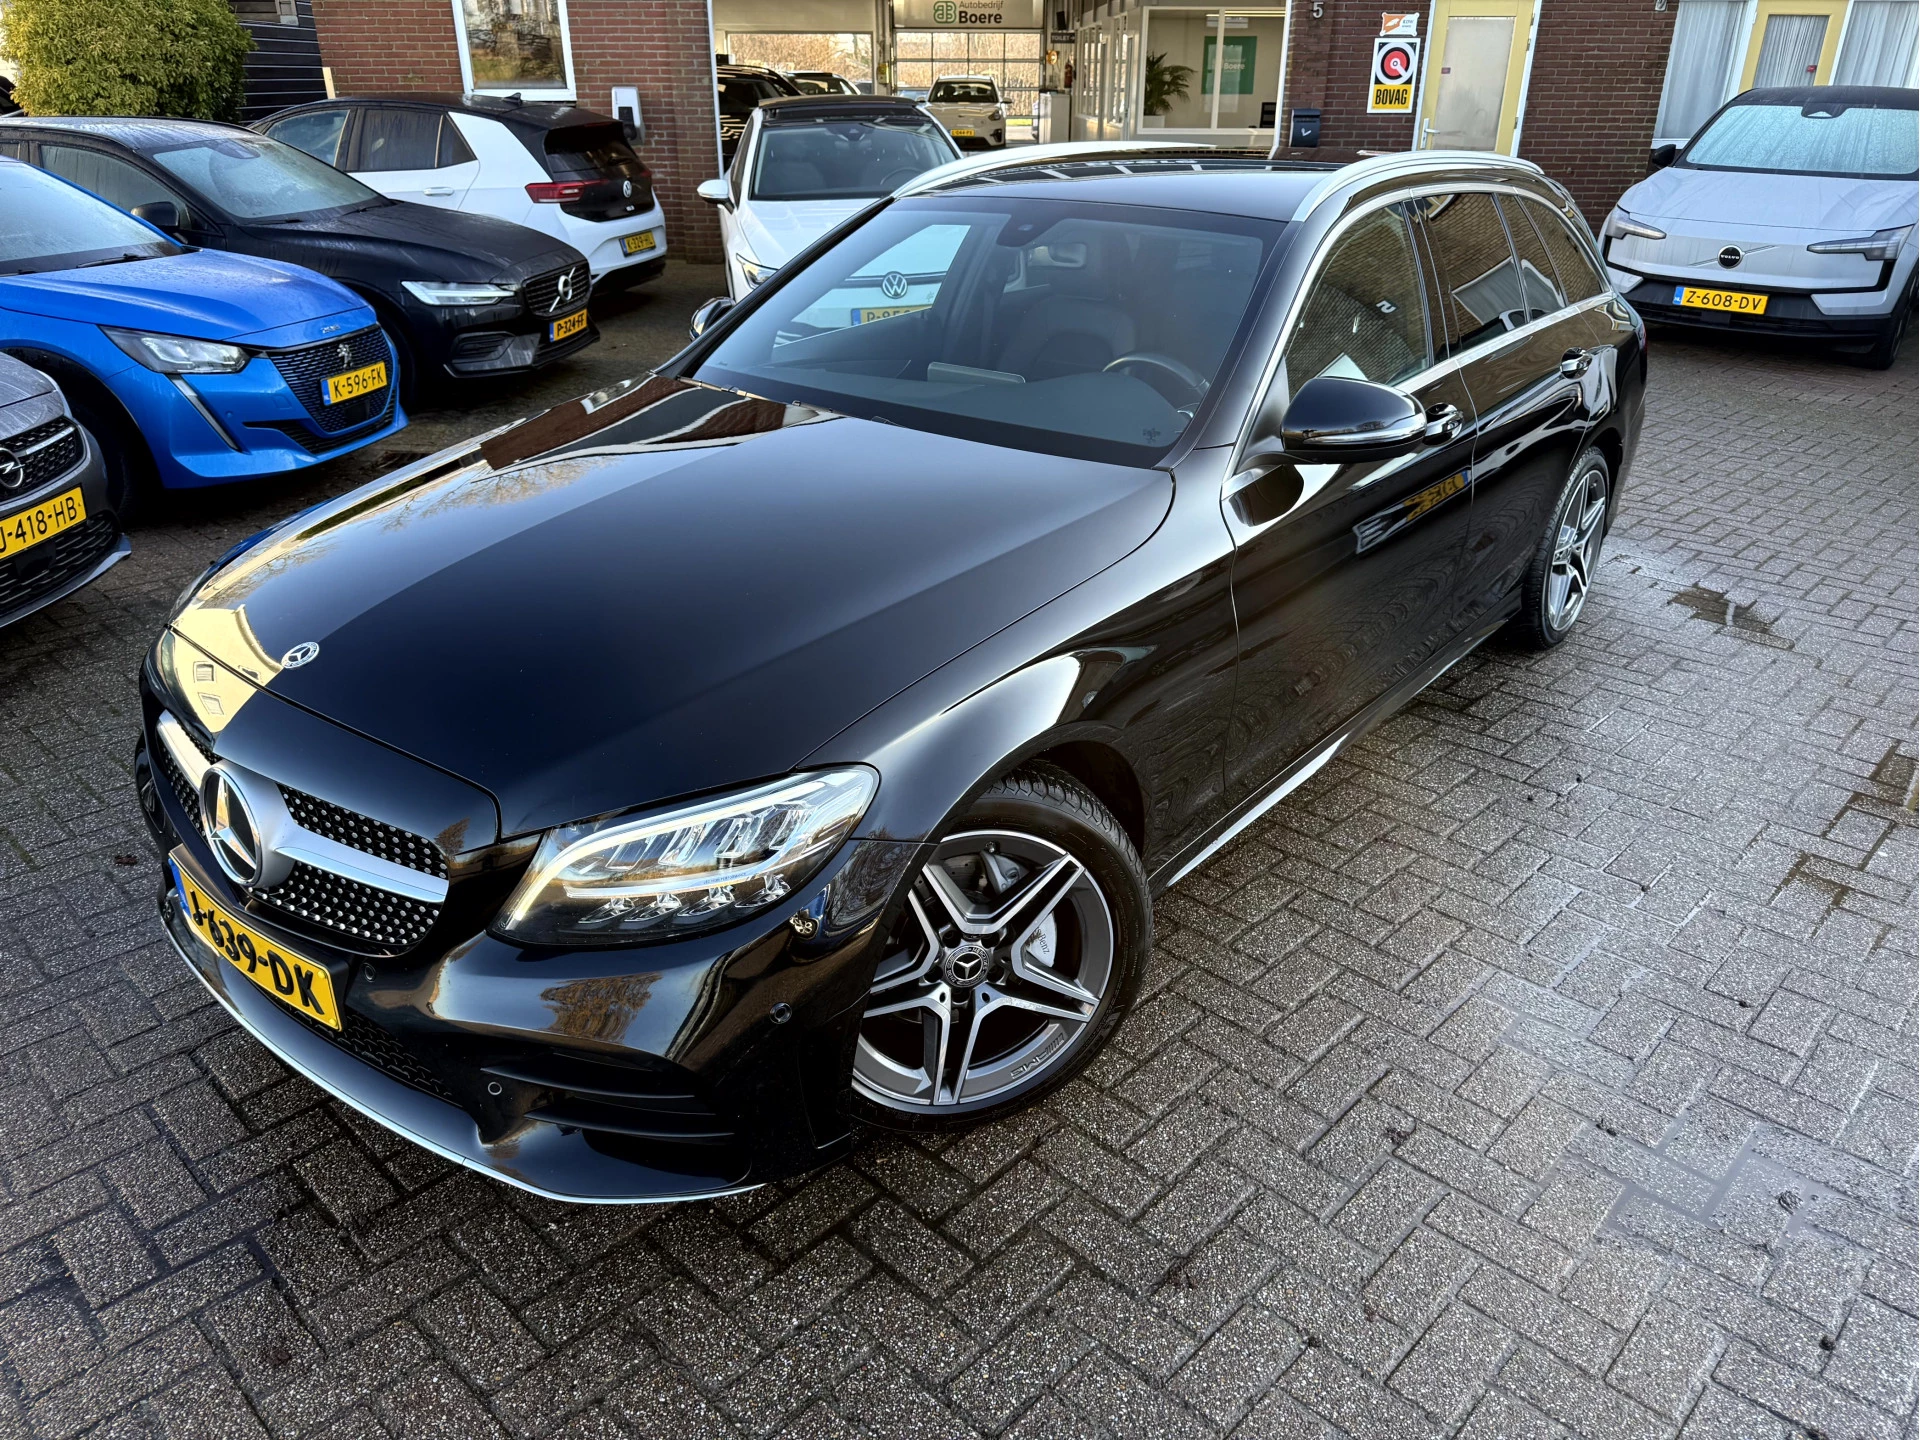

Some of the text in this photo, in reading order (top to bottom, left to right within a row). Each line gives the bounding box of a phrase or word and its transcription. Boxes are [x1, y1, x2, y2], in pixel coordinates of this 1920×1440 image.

[959, 1, 1003, 10] Autobedrijf
[1312, 2, 1324, 18] 5
[959, 11, 1003, 24] Boere
[1223, 62, 1245, 70] Boere
[1375, 89, 1408, 105] BOVAG
[1686, 290, 1762, 311] Z-608-DV
[333, 366, 384, 399] K-596-FK
[189, 889, 325, 1014] J-639-DK
